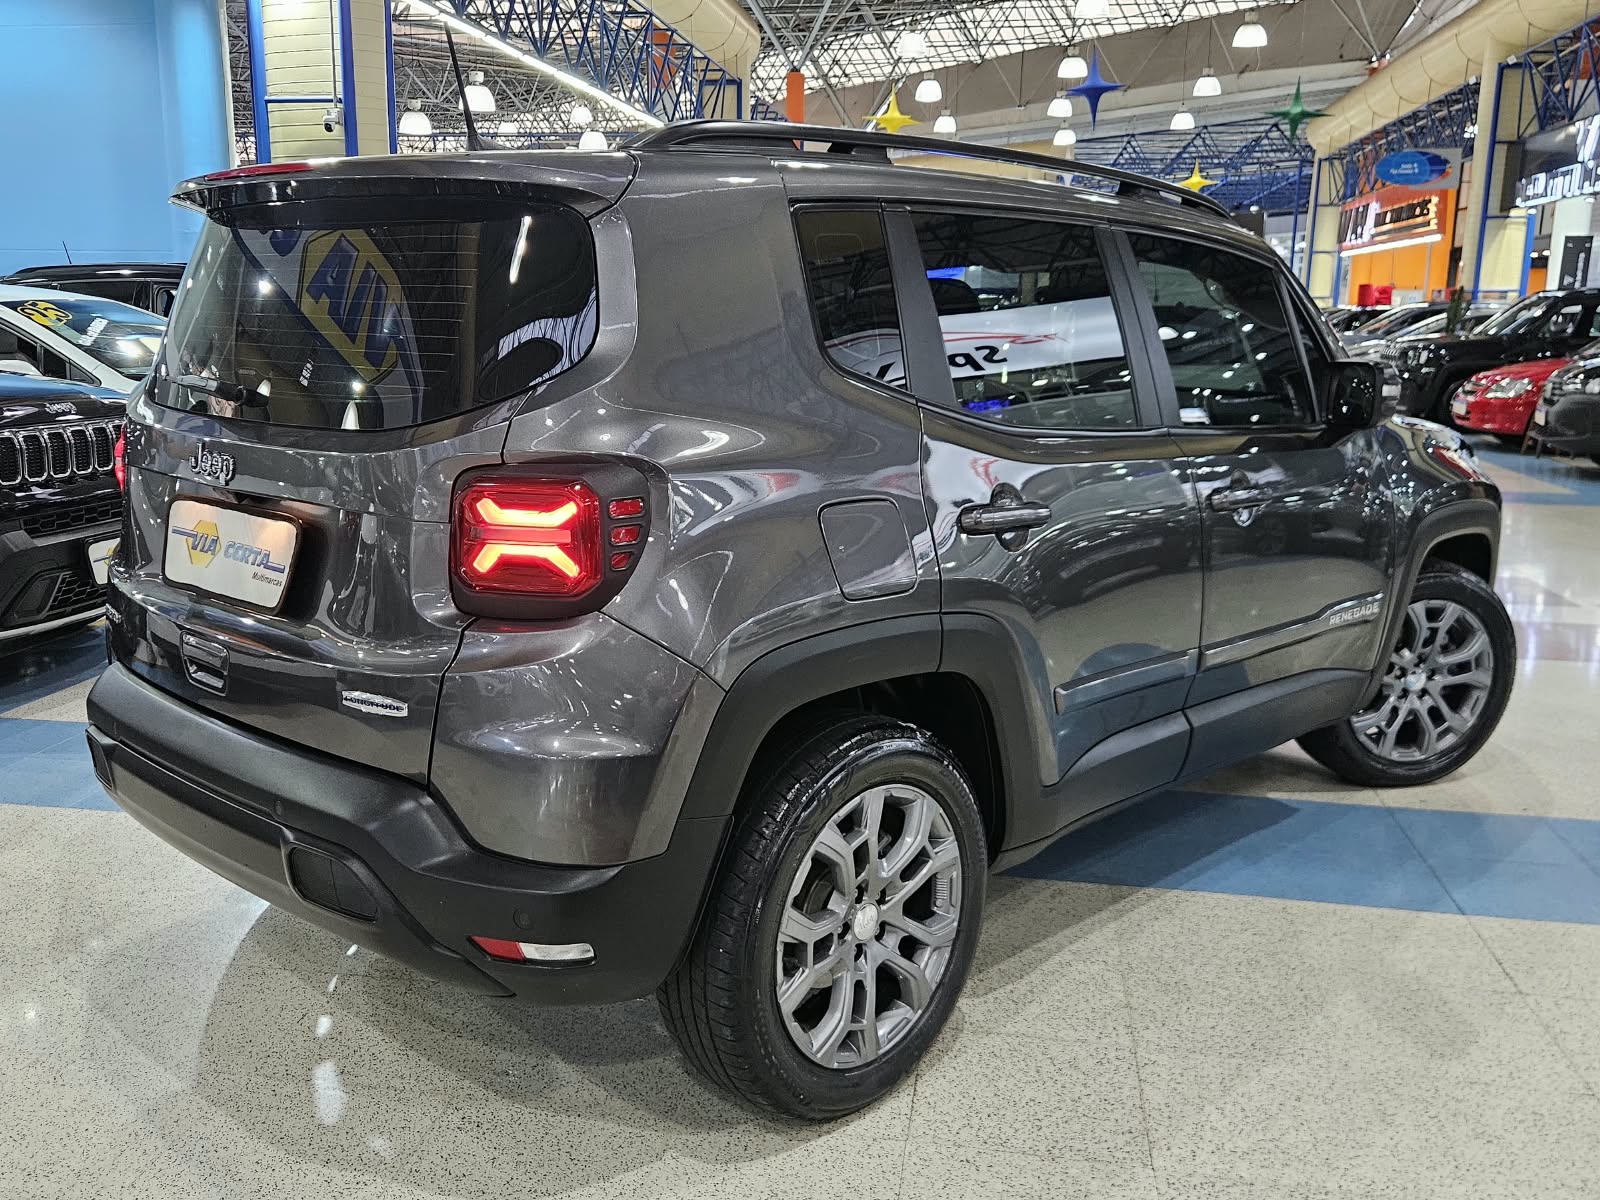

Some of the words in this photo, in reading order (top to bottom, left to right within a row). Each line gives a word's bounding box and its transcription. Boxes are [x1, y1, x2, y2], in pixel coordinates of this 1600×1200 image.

[189, 441, 235, 486] Jeep
[188, 531, 219, 555] VIA
[223, 541, 271, 567] CERTA
[251, 571, 283, 587] Multimarcas
[343, 695, 405, 712] LONGITUDE
